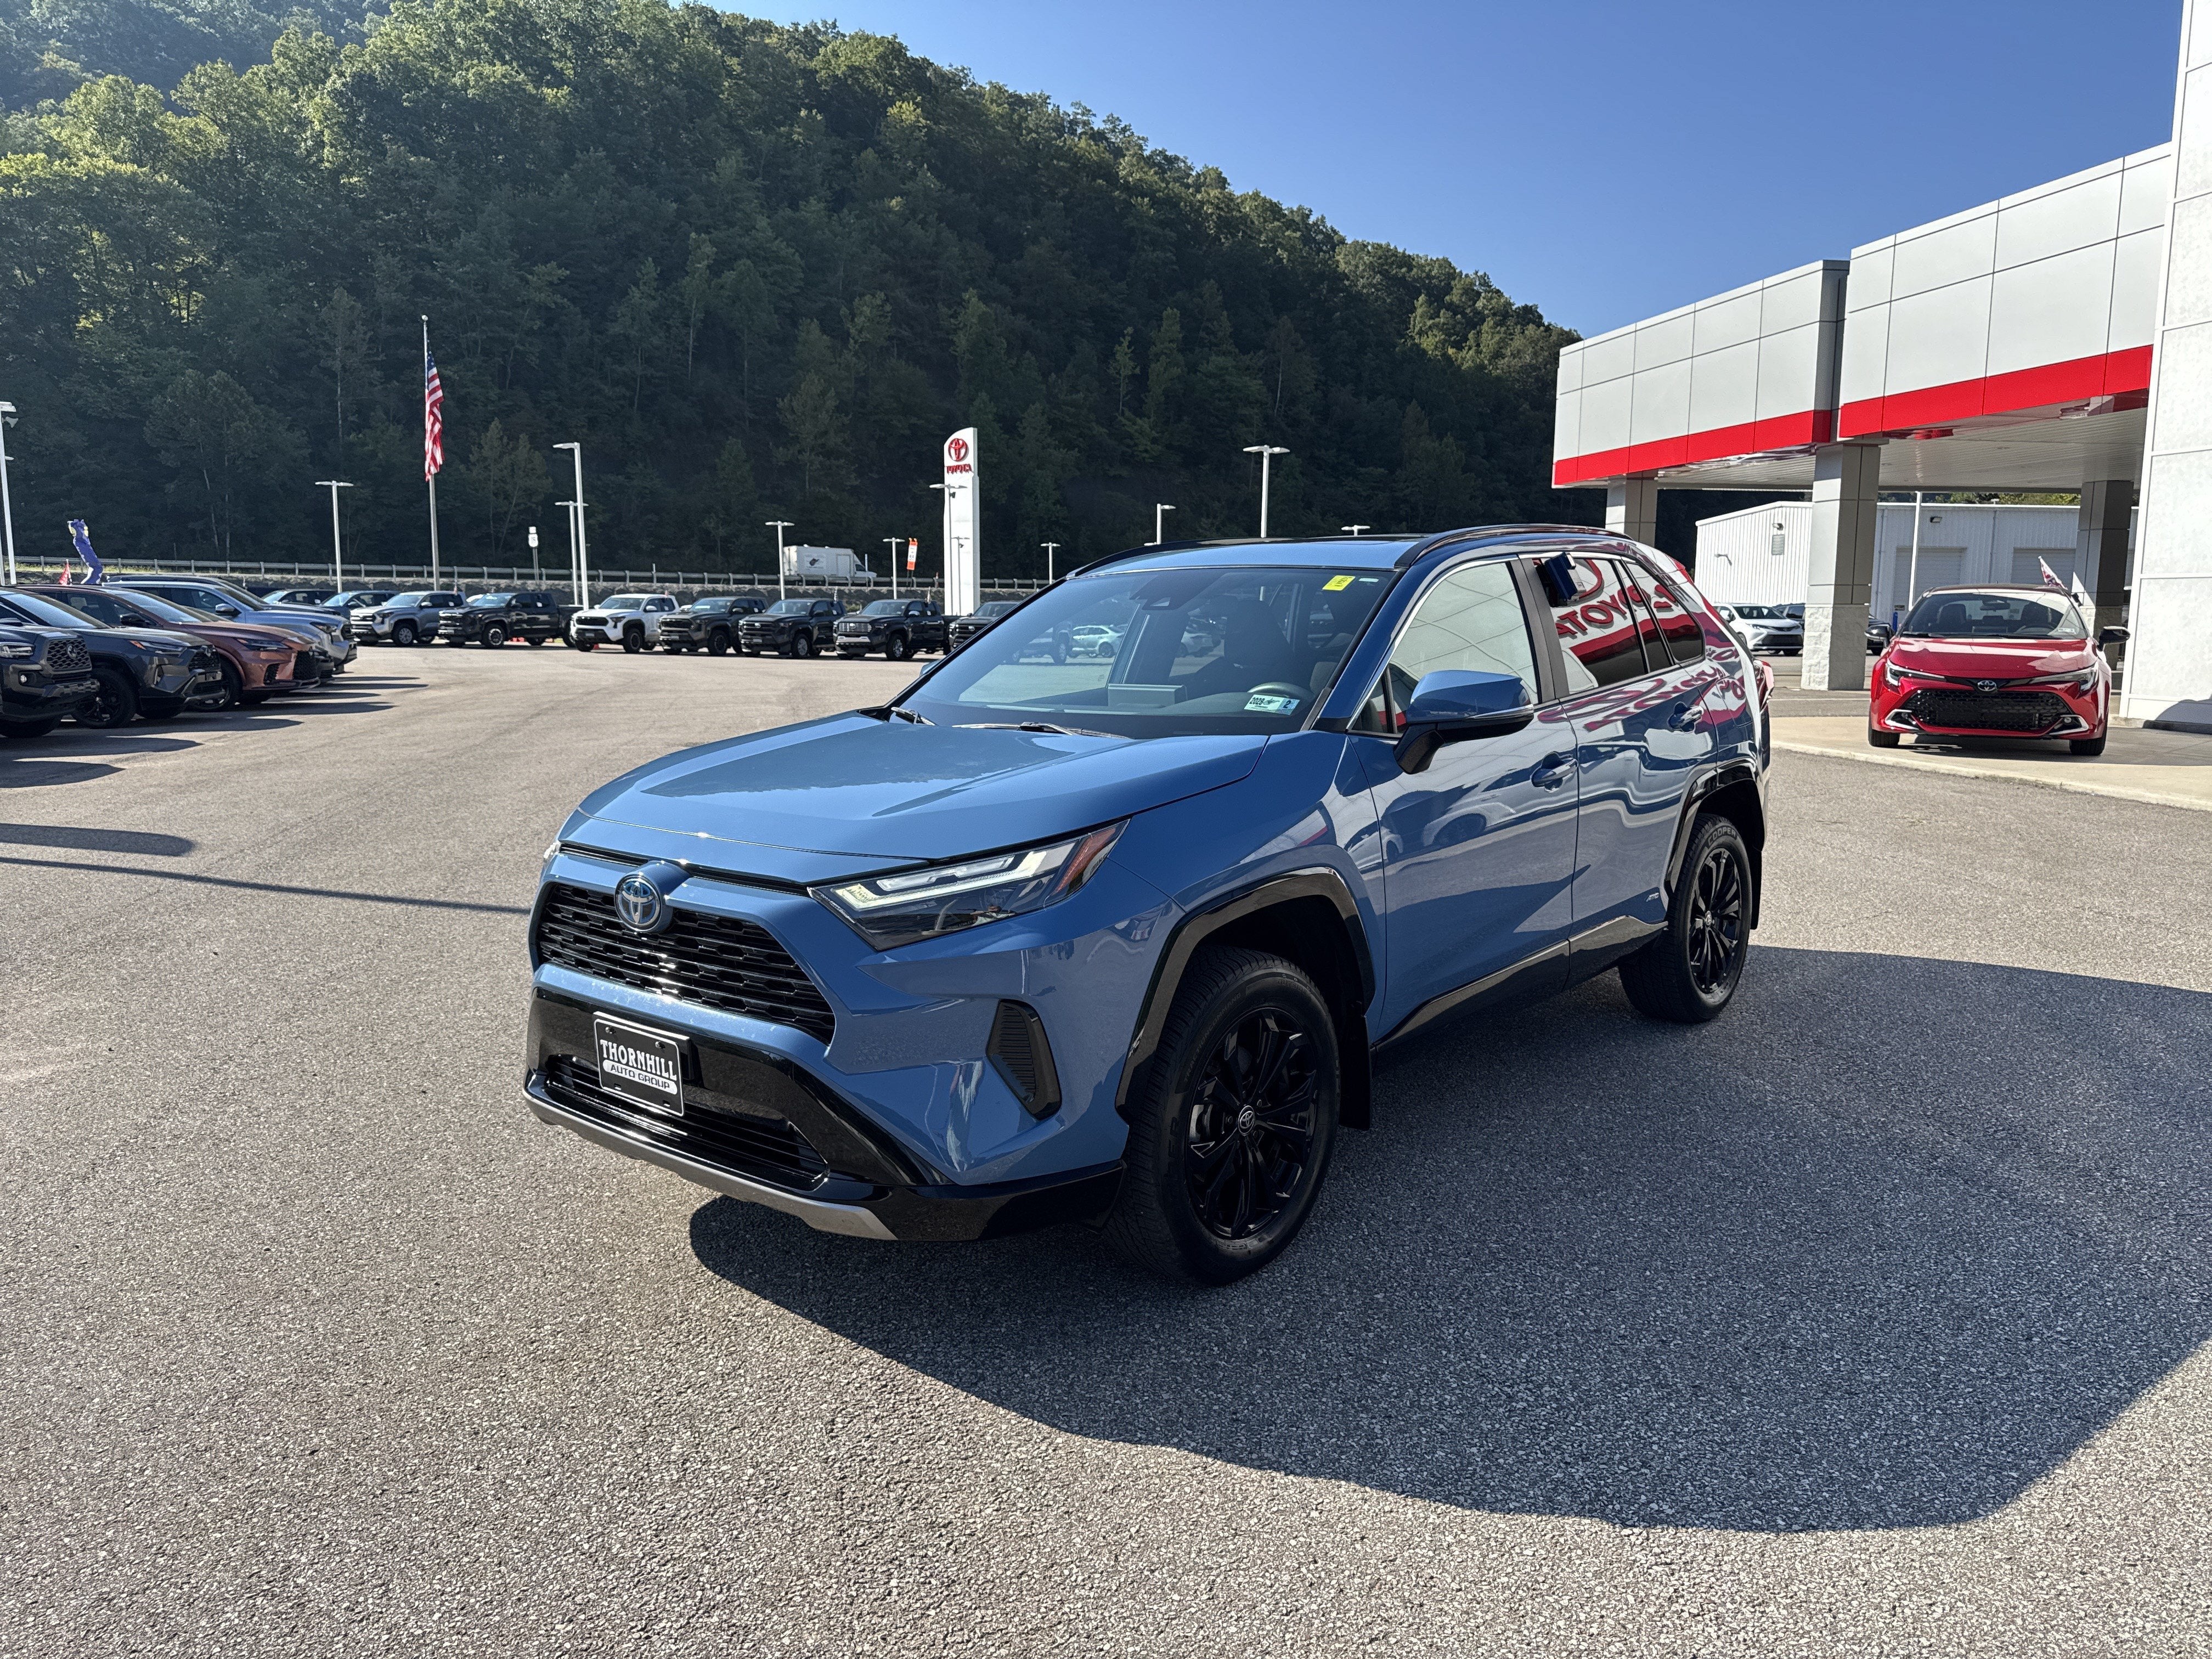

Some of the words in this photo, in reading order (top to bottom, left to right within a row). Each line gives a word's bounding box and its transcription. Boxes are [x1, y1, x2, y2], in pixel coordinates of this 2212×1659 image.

[1283, 700, 1291, 709] 2
[1708, 827, 1736, 846] COOPER
[600, 1039, 677, 1081] THORNHILL
[611, 1064, 635, 1078] AUTO
[638, 1073, 670, 1089] GROUP
